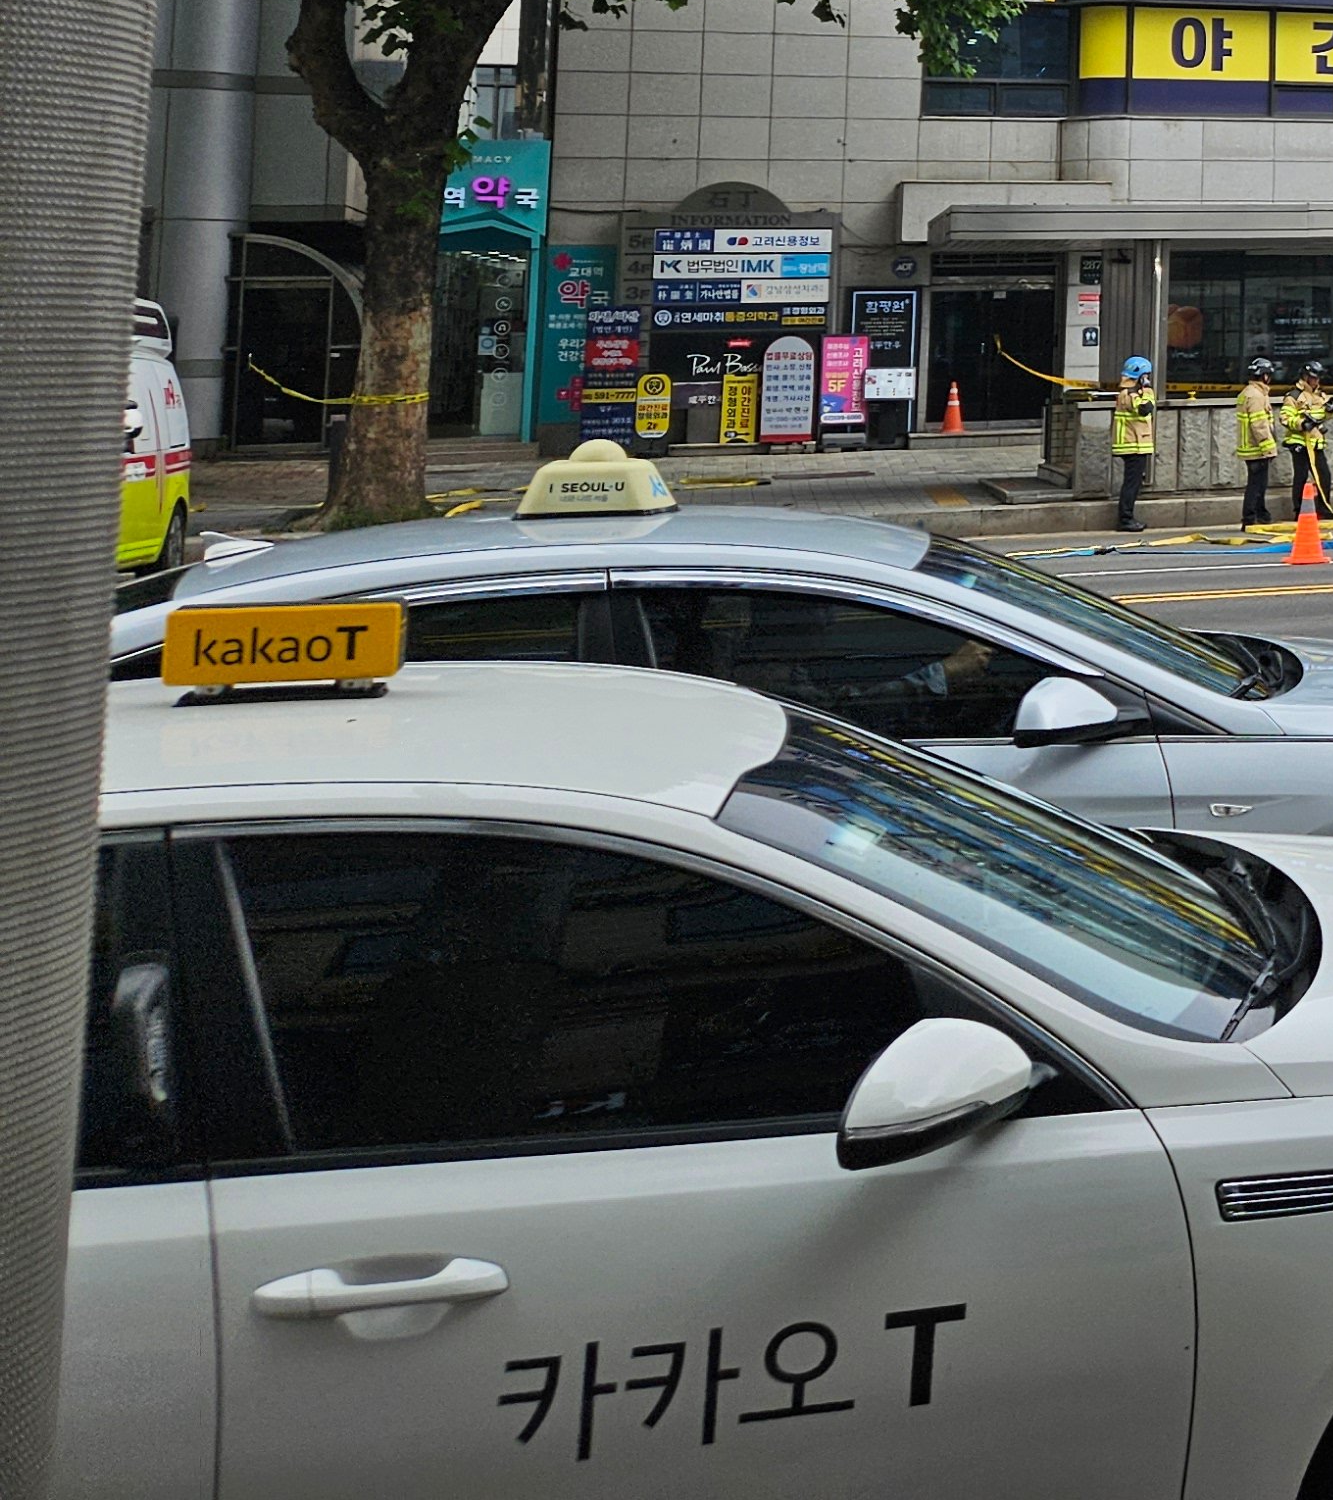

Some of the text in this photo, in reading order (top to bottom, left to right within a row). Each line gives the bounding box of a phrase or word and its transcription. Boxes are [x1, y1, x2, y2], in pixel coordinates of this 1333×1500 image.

[472, 155, 512, 164] MACY
[670, 213, 792, 226] INFORMATION
[752, 235, 820, 247] 고려신용정보
[567, 266, 605, 278] 교대역
[687, 258, 739, 273] 법무법인
[741, 259, 775, 273] IMK
[558, 279, 612, 308] 약국
[866, 300, 905, 313] 함평원
[766, 352, 813, 361] 법률무료상담
[827, 379, 847, 393] 5F
[851, 347, 864, 412] 고려신용정보
[638, 403, 669, 412] 야간진료
[726, 386, 738, 429] 정형외과
[739, 386, 753, 429] 야간진료
[645, 421, 659, 431] 2F
[496, 1303, 969, 1462] 카카오 T
